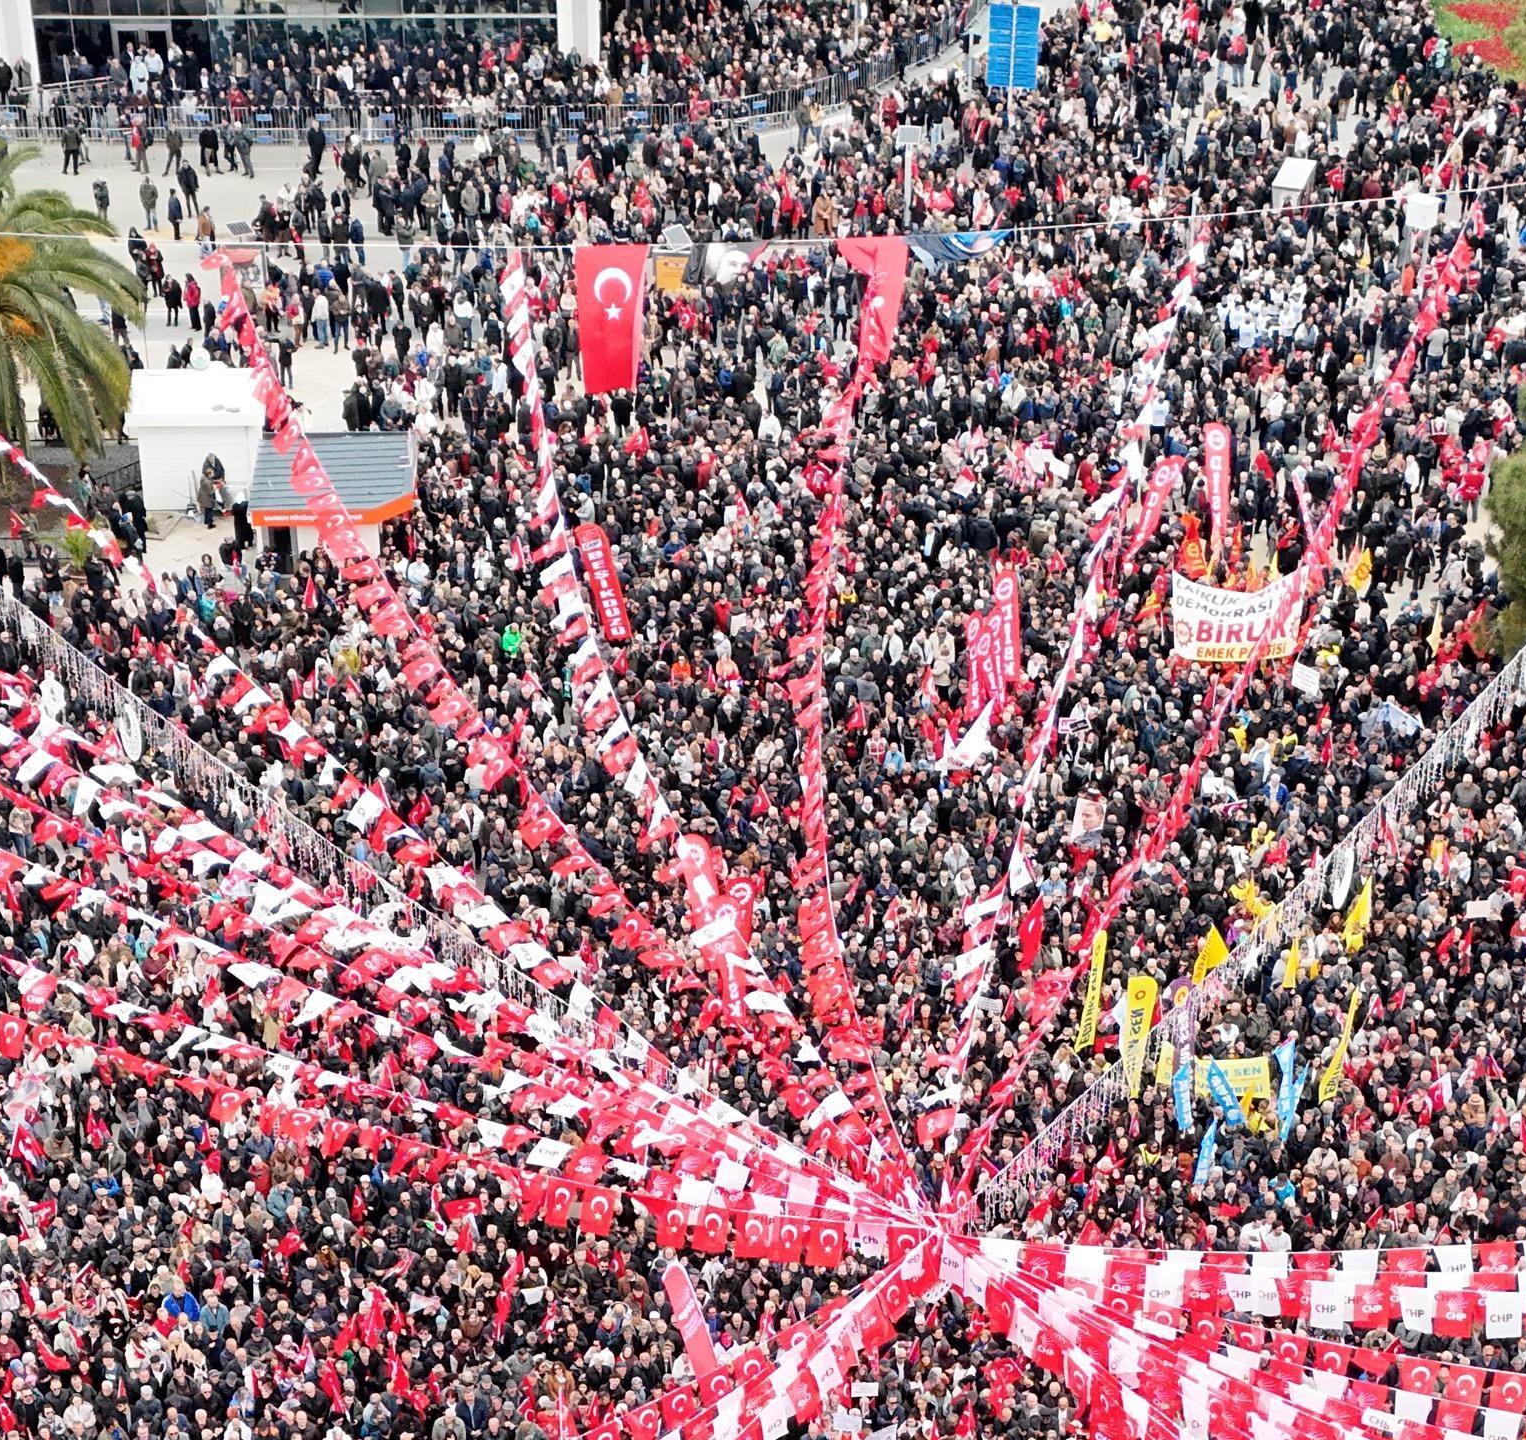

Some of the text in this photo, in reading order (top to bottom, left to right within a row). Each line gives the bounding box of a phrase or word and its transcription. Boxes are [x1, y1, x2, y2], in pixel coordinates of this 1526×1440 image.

[1196, 646, 1238, 659] EMEK
[539, 1149, 559, 1157] CHP
[1189, 1291, 1211, 1300] CHP
[1315, 1304, 1336, 1314] CHP
[1362, 1305, 1383, 1314] CHP
[1445, 1311, 1467, 1321] CHP
[1490, 1313, 1513, 1323] CHP
